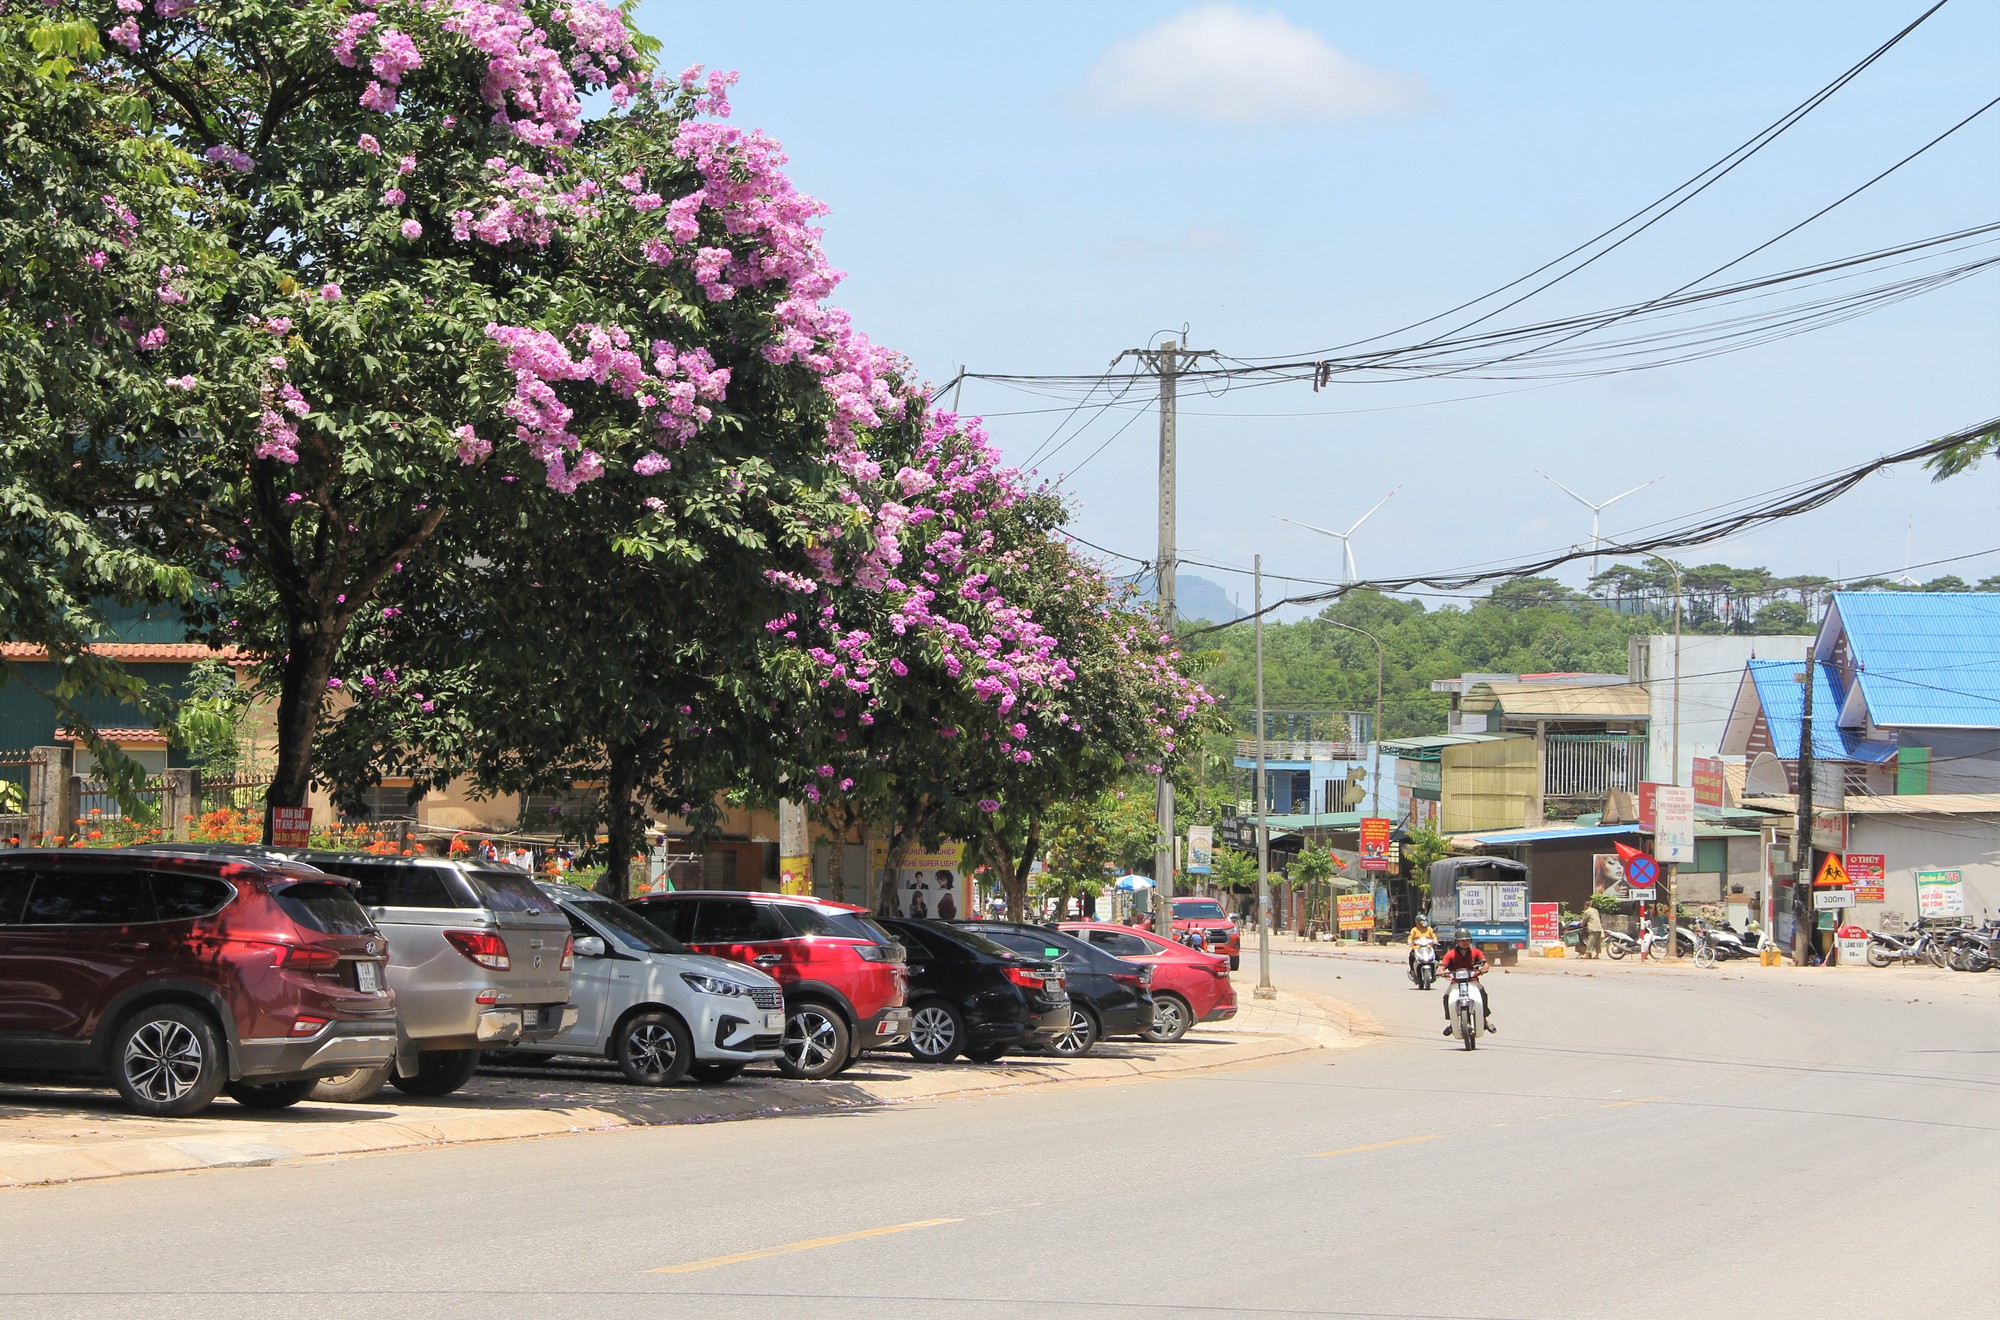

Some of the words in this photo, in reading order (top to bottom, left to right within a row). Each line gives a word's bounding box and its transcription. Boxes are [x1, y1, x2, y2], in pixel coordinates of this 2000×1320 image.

[294, 820, 309, 830] SANH
[1946, 871, 1960, 883] 76
[1823, 895, 1846, 904] 300m
